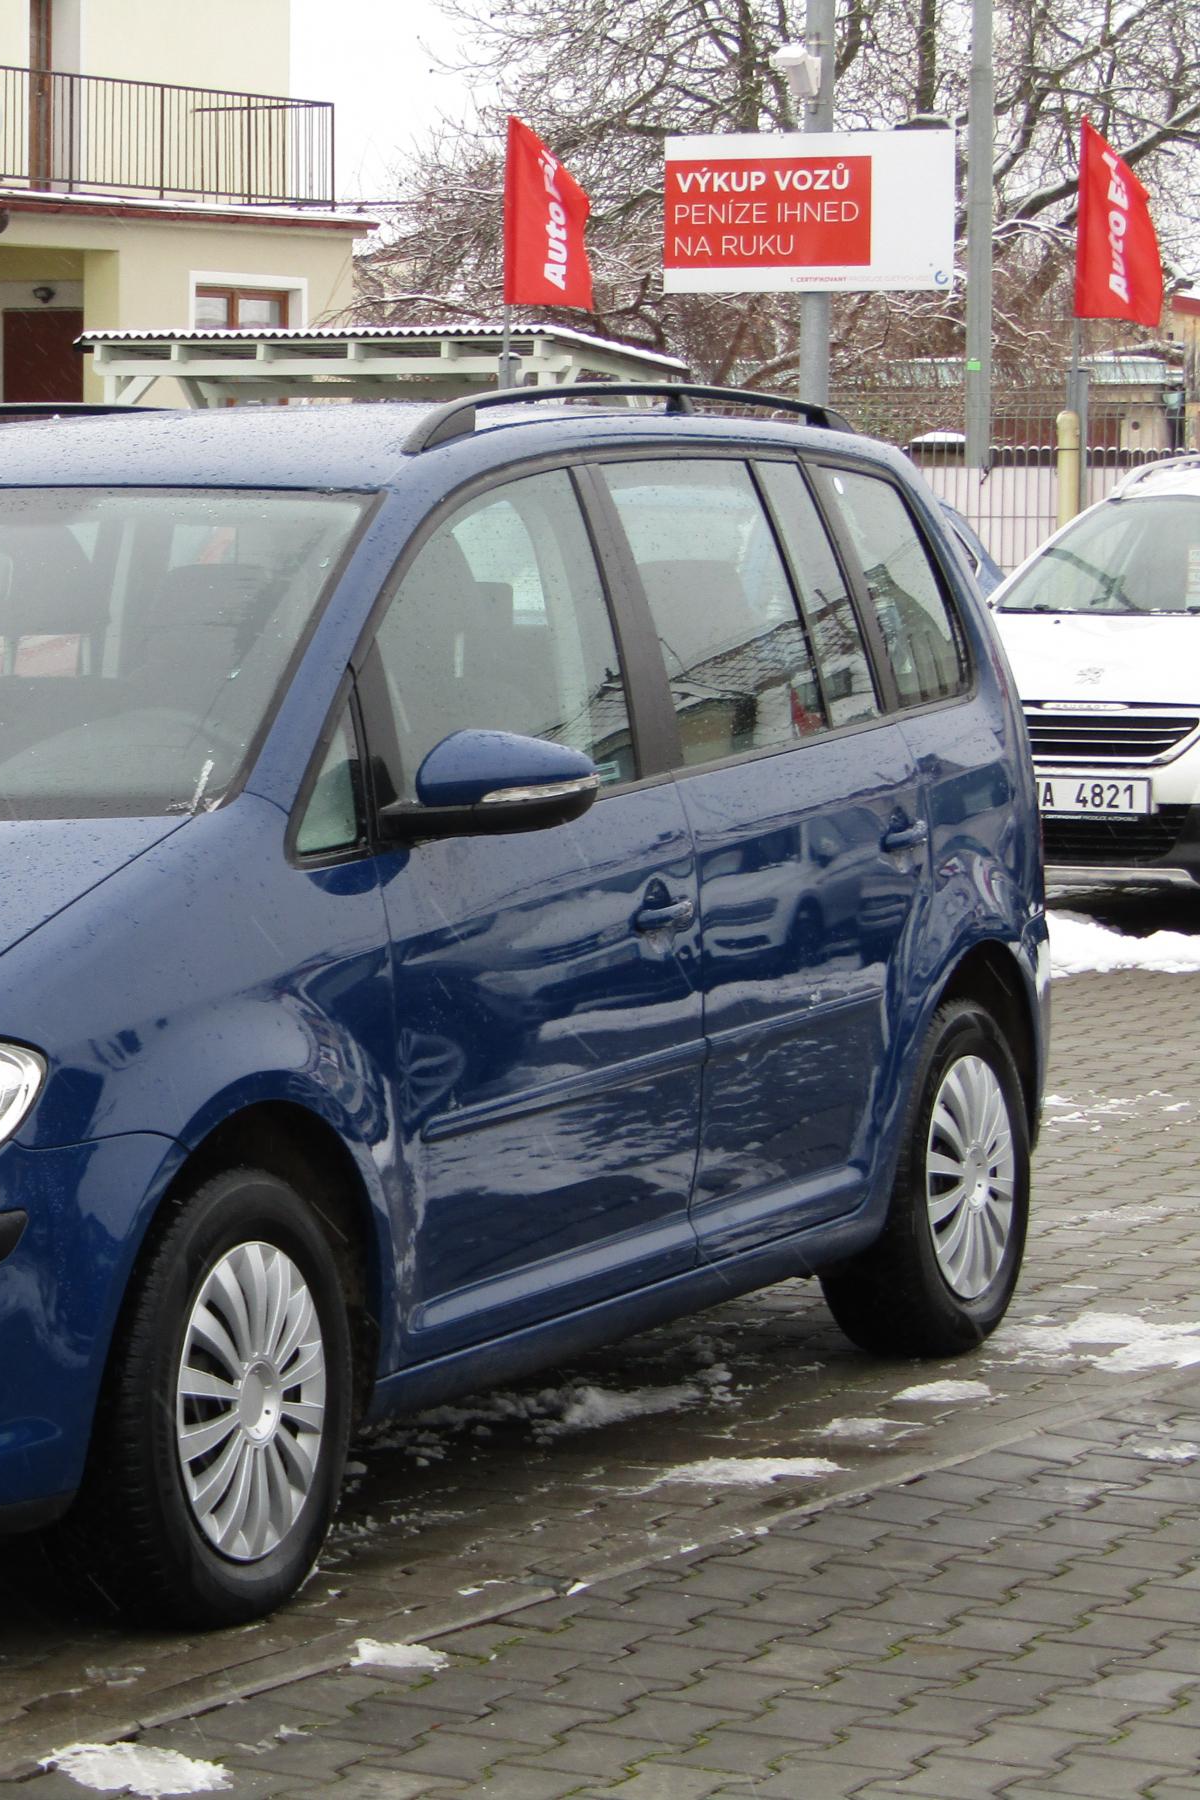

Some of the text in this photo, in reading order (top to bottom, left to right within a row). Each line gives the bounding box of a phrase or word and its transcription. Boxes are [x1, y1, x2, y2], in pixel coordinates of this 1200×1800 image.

[675, 162, 850, 193] VÝKUP VOZŮ
[674, 200, 860, 225] PENÍZE IHNED
[543, 202, 568, 290] Auto
[674, 234, 794, 257] NA RUKU
[1075, 783, 1134, 809] 4821
